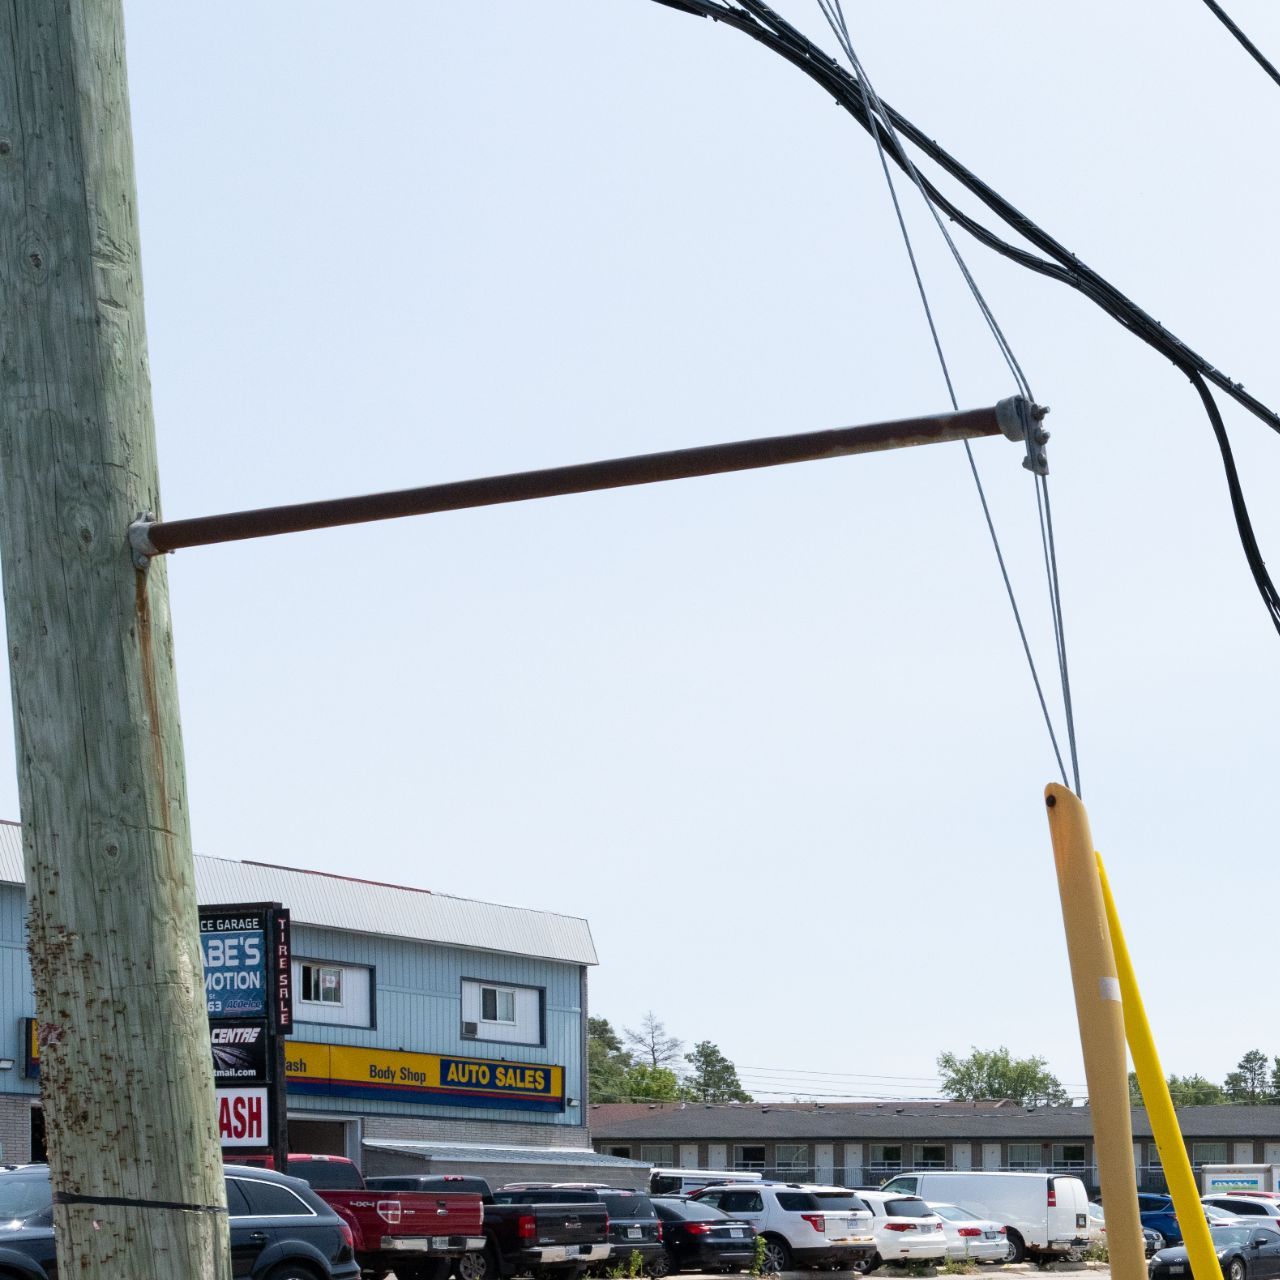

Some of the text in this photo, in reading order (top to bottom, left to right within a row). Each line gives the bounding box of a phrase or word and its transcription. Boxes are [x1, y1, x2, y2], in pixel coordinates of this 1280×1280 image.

[216, 918, 259, 930] GARAGE
[278, 919, 290, 1025] TIRE SALE
[211, 1027, 261, 1044] CENTRE
[285, 1058, 426, 1084] ash Body Shop
[447, 1062, 545, 1090] AUTO SALES
[217, 1096, 262, 1139] ASH
